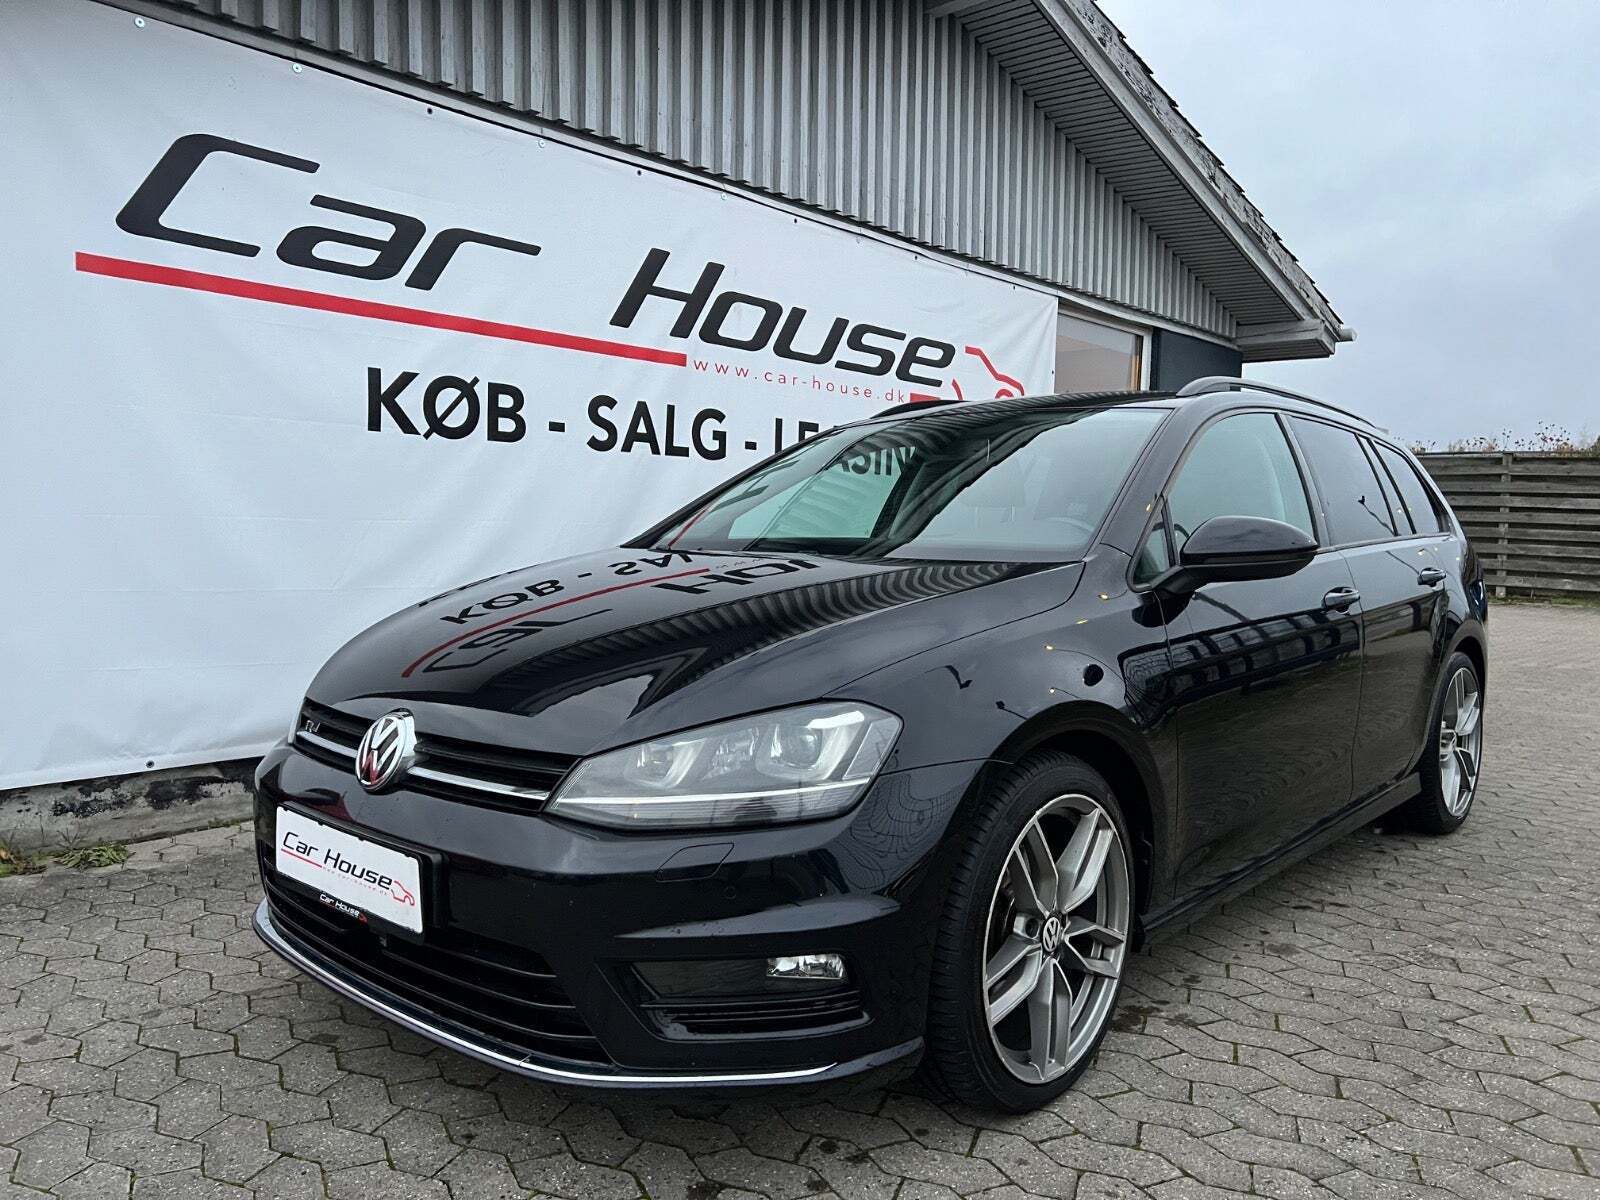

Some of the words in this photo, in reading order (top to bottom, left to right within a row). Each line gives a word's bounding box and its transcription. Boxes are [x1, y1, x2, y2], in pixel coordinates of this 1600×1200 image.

[115, 133, 541, 290] Car
[610, 247, 955, 388] House
[693, 359, 905, 403] www.car-house.dk
[367, 366, 527, 443] KØB
[587, 395, 727, 461] SALG
[283, 831, 319, 857] Car
[323, 848, 393, 891] House
[319, 893, 335, 904] Car
